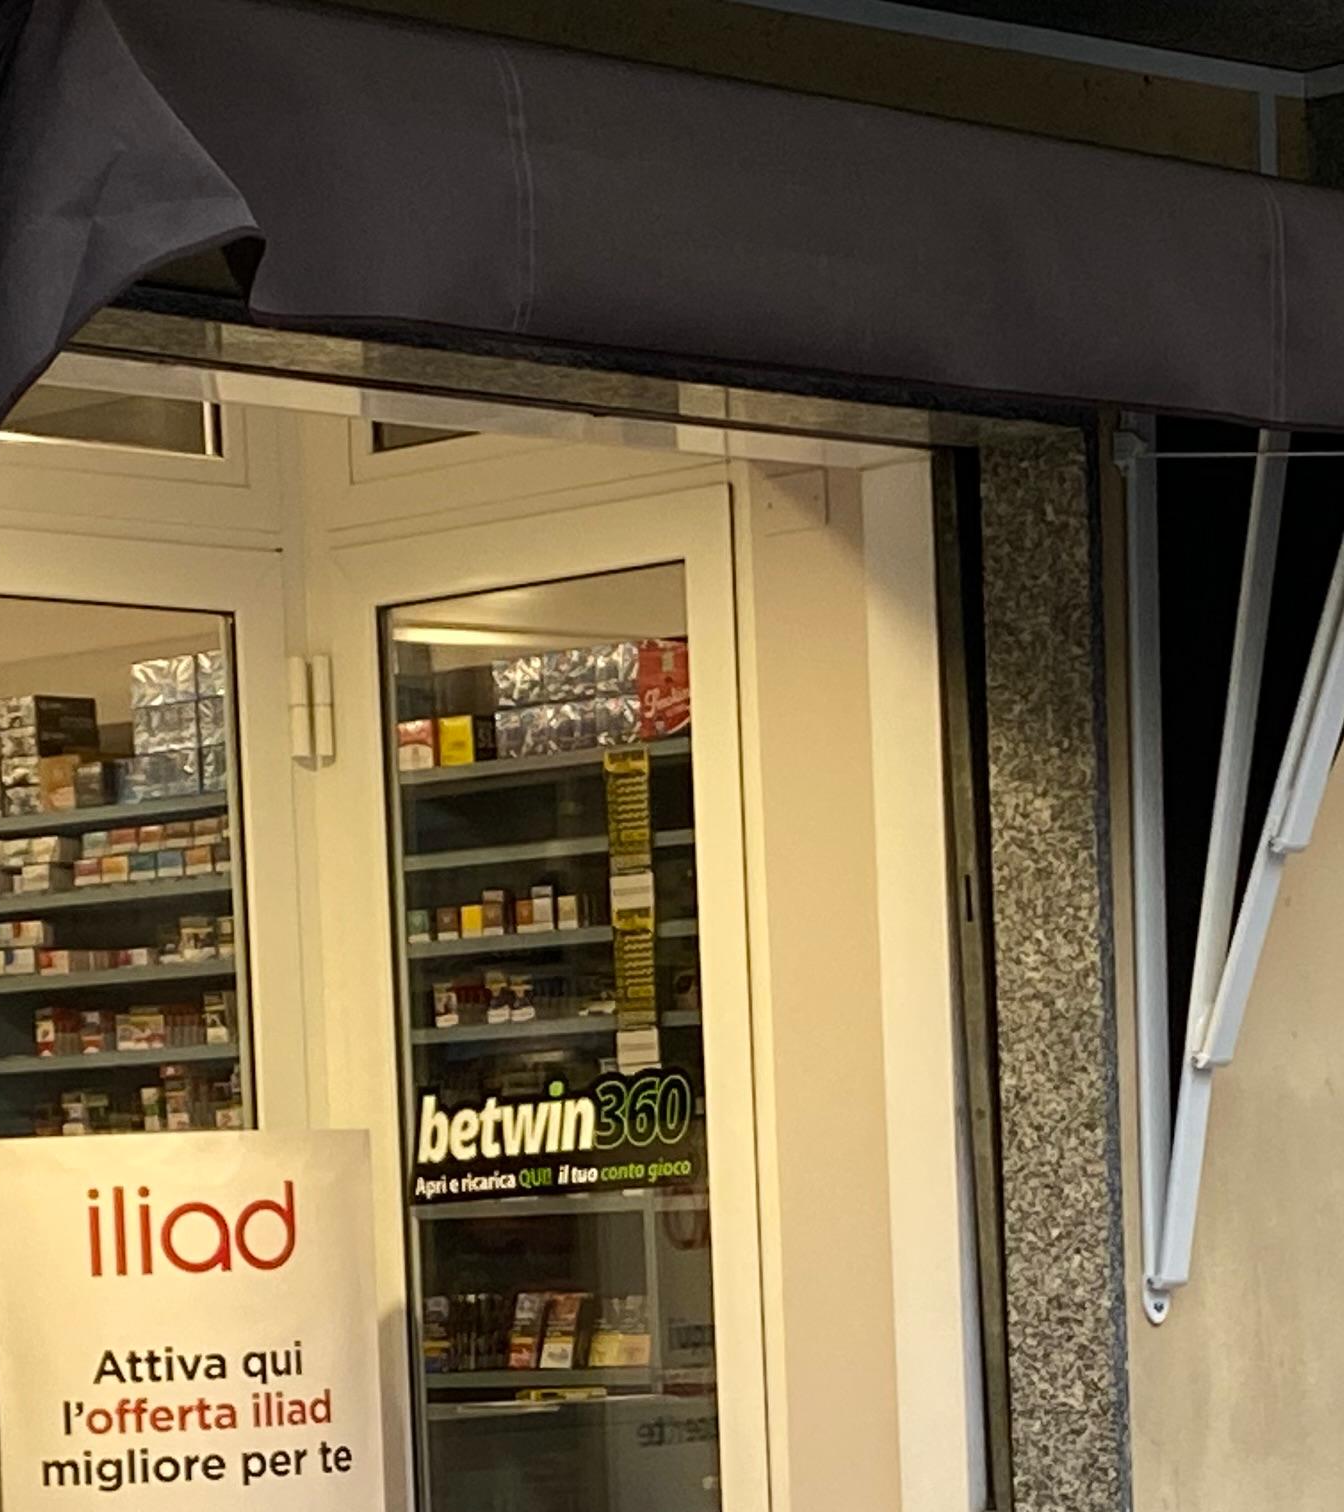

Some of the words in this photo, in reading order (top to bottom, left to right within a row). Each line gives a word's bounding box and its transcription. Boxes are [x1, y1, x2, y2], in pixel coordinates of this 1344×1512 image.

[417, 1074, 691, 1164] betwin360
[415, 1175, 448, 1200] Apri
[450, 1179, 459, 1194] e
[462, 1171, 516, 1192] ricarica
[558, 1164, 569, 1185] il
[571, 1166, 598, 1184] tuo
[600, 1162, 644, 1182] conto
[648, 1159, 691, 1184] gioco
[87, 1180, 296, 1277] iliad
[93, 1346, 227, 1385] Attiva
[242, 1341, 303, 1384] qui
[252, 1389, 332, 1429] iliad
[41, 1448, 226, 1491] migliore
[242, 1447, 307, 1486] per
[319, 1441, 353, 1474] te
